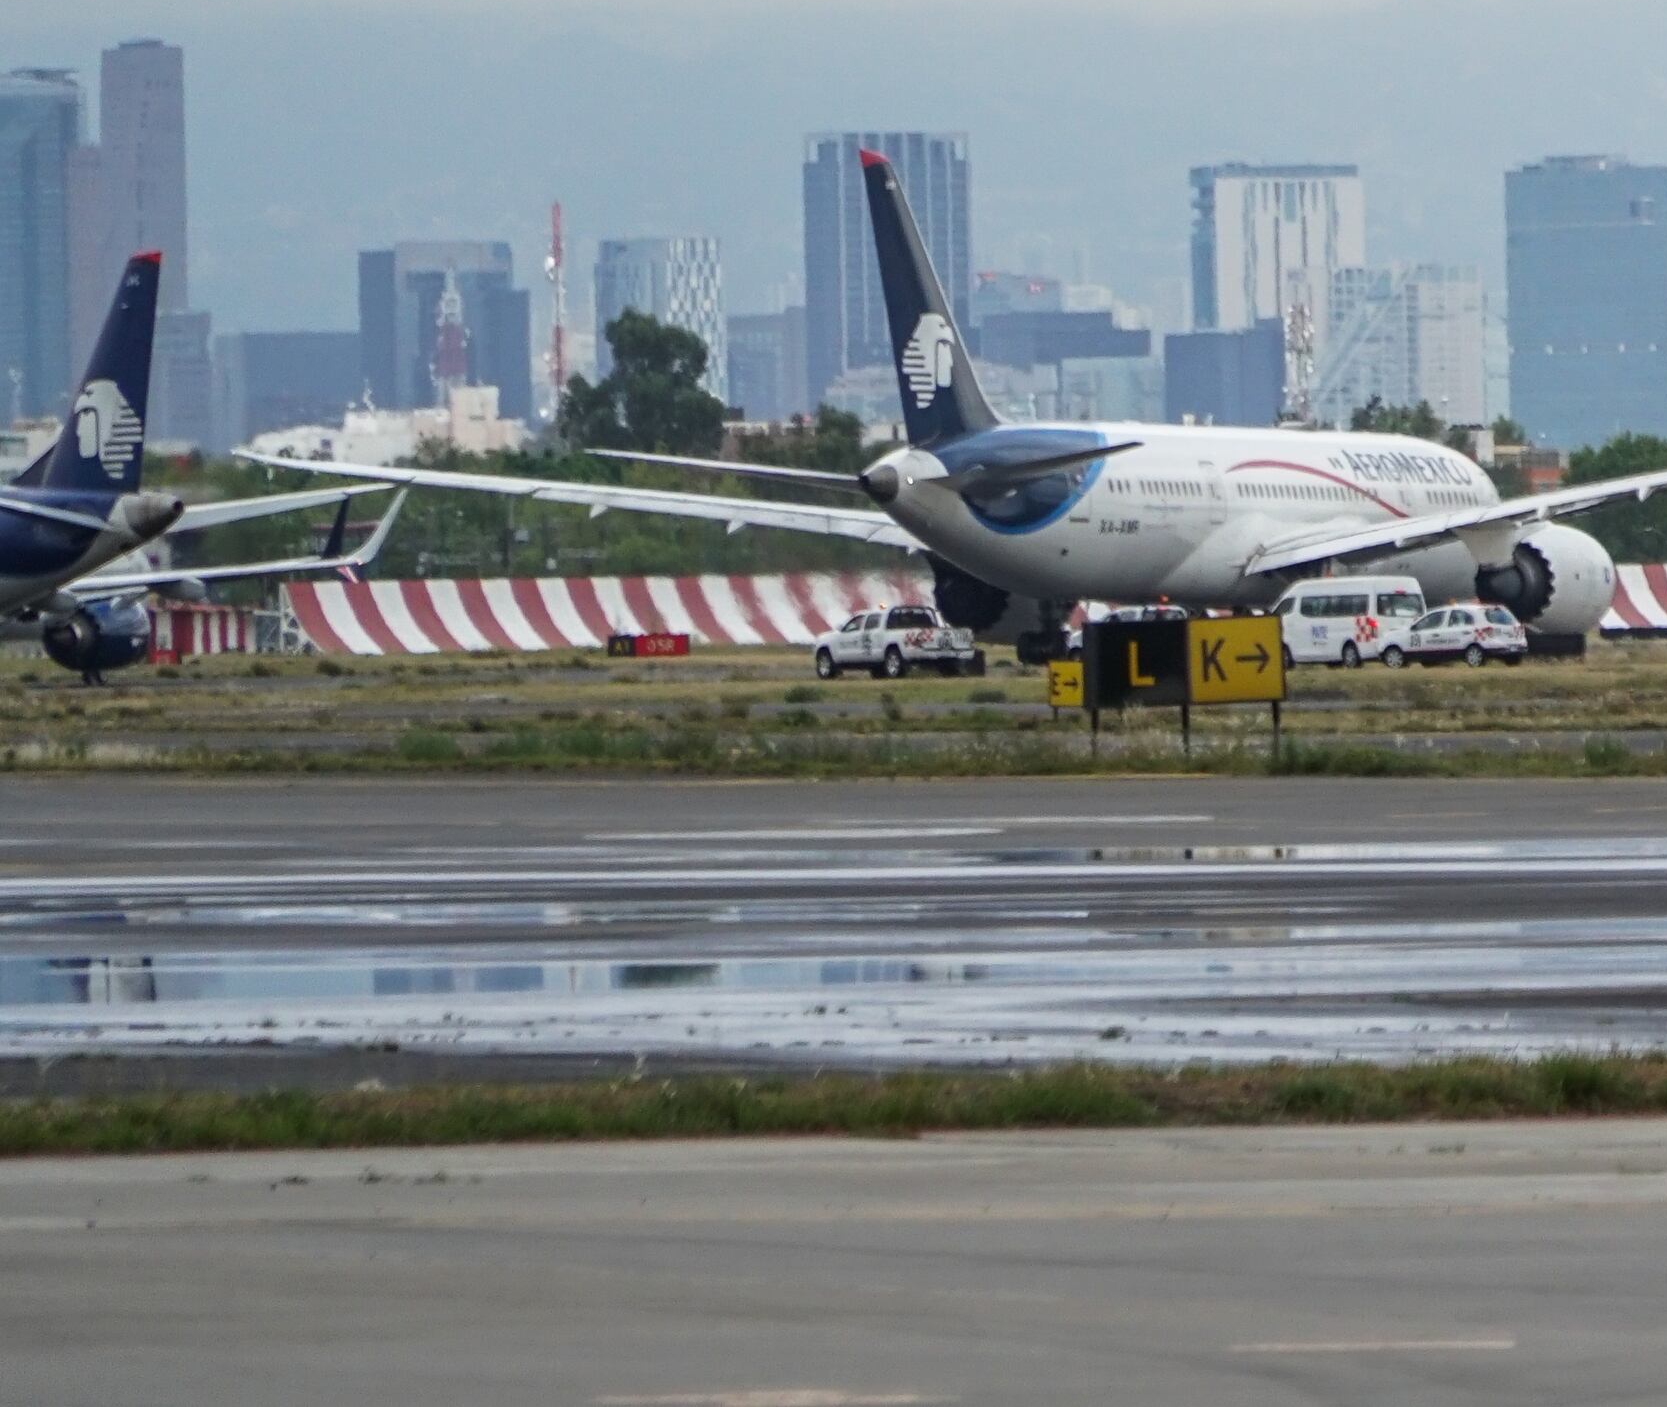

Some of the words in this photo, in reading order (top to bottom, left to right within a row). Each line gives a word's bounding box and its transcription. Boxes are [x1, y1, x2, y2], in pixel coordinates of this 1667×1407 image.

[1341, 449, 1472, 486] AEROMEXICO
[1128, 641, 1156, 687] L
[1200, 638, 1228, 682] K
